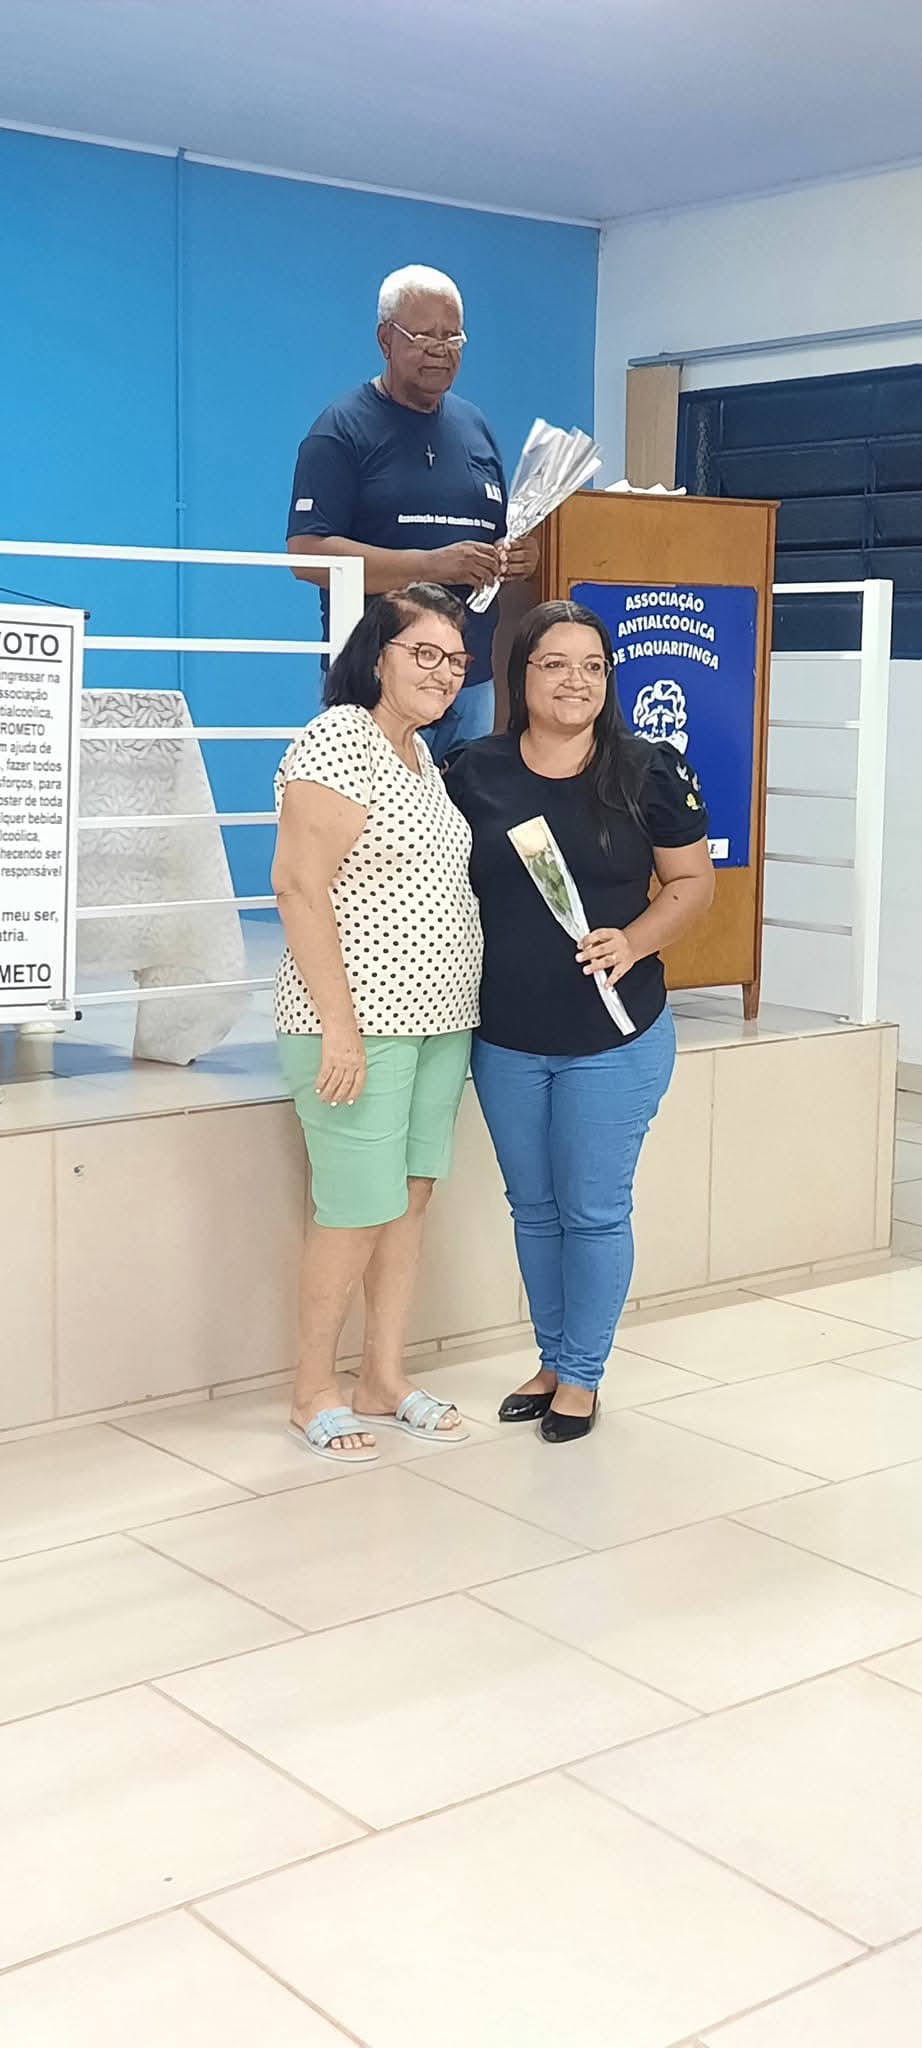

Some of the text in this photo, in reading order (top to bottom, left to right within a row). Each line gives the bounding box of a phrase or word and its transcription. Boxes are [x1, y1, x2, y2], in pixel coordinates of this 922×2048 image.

[626, 592, 704, 612] ASSOCIAÇÃO
[618, 614, 715, 641] ANTIALCOOLICA
[0, 631, 60, 656] OTO
[627, 640, 719, 670] TAQUARITINGA
[47, 674, 61, 684] na
[10, 741, 36, 756] ajuda
[39, 741, 51, 754] de
[6, 758, 31, 771] fazer
[33, 760, 62, 772] todos
[39, 780, 61, 792] para
[25, 794, 37, 806] de
[40, 795, 62, 807] toda
[28, 812, 62, 824] bebida
[45, 850, 62, 859] ser
[1, 864, 62, 879] responsável
[2, 911, 58, 923] meu ser,
[0, 928, 28, 941] tria.
